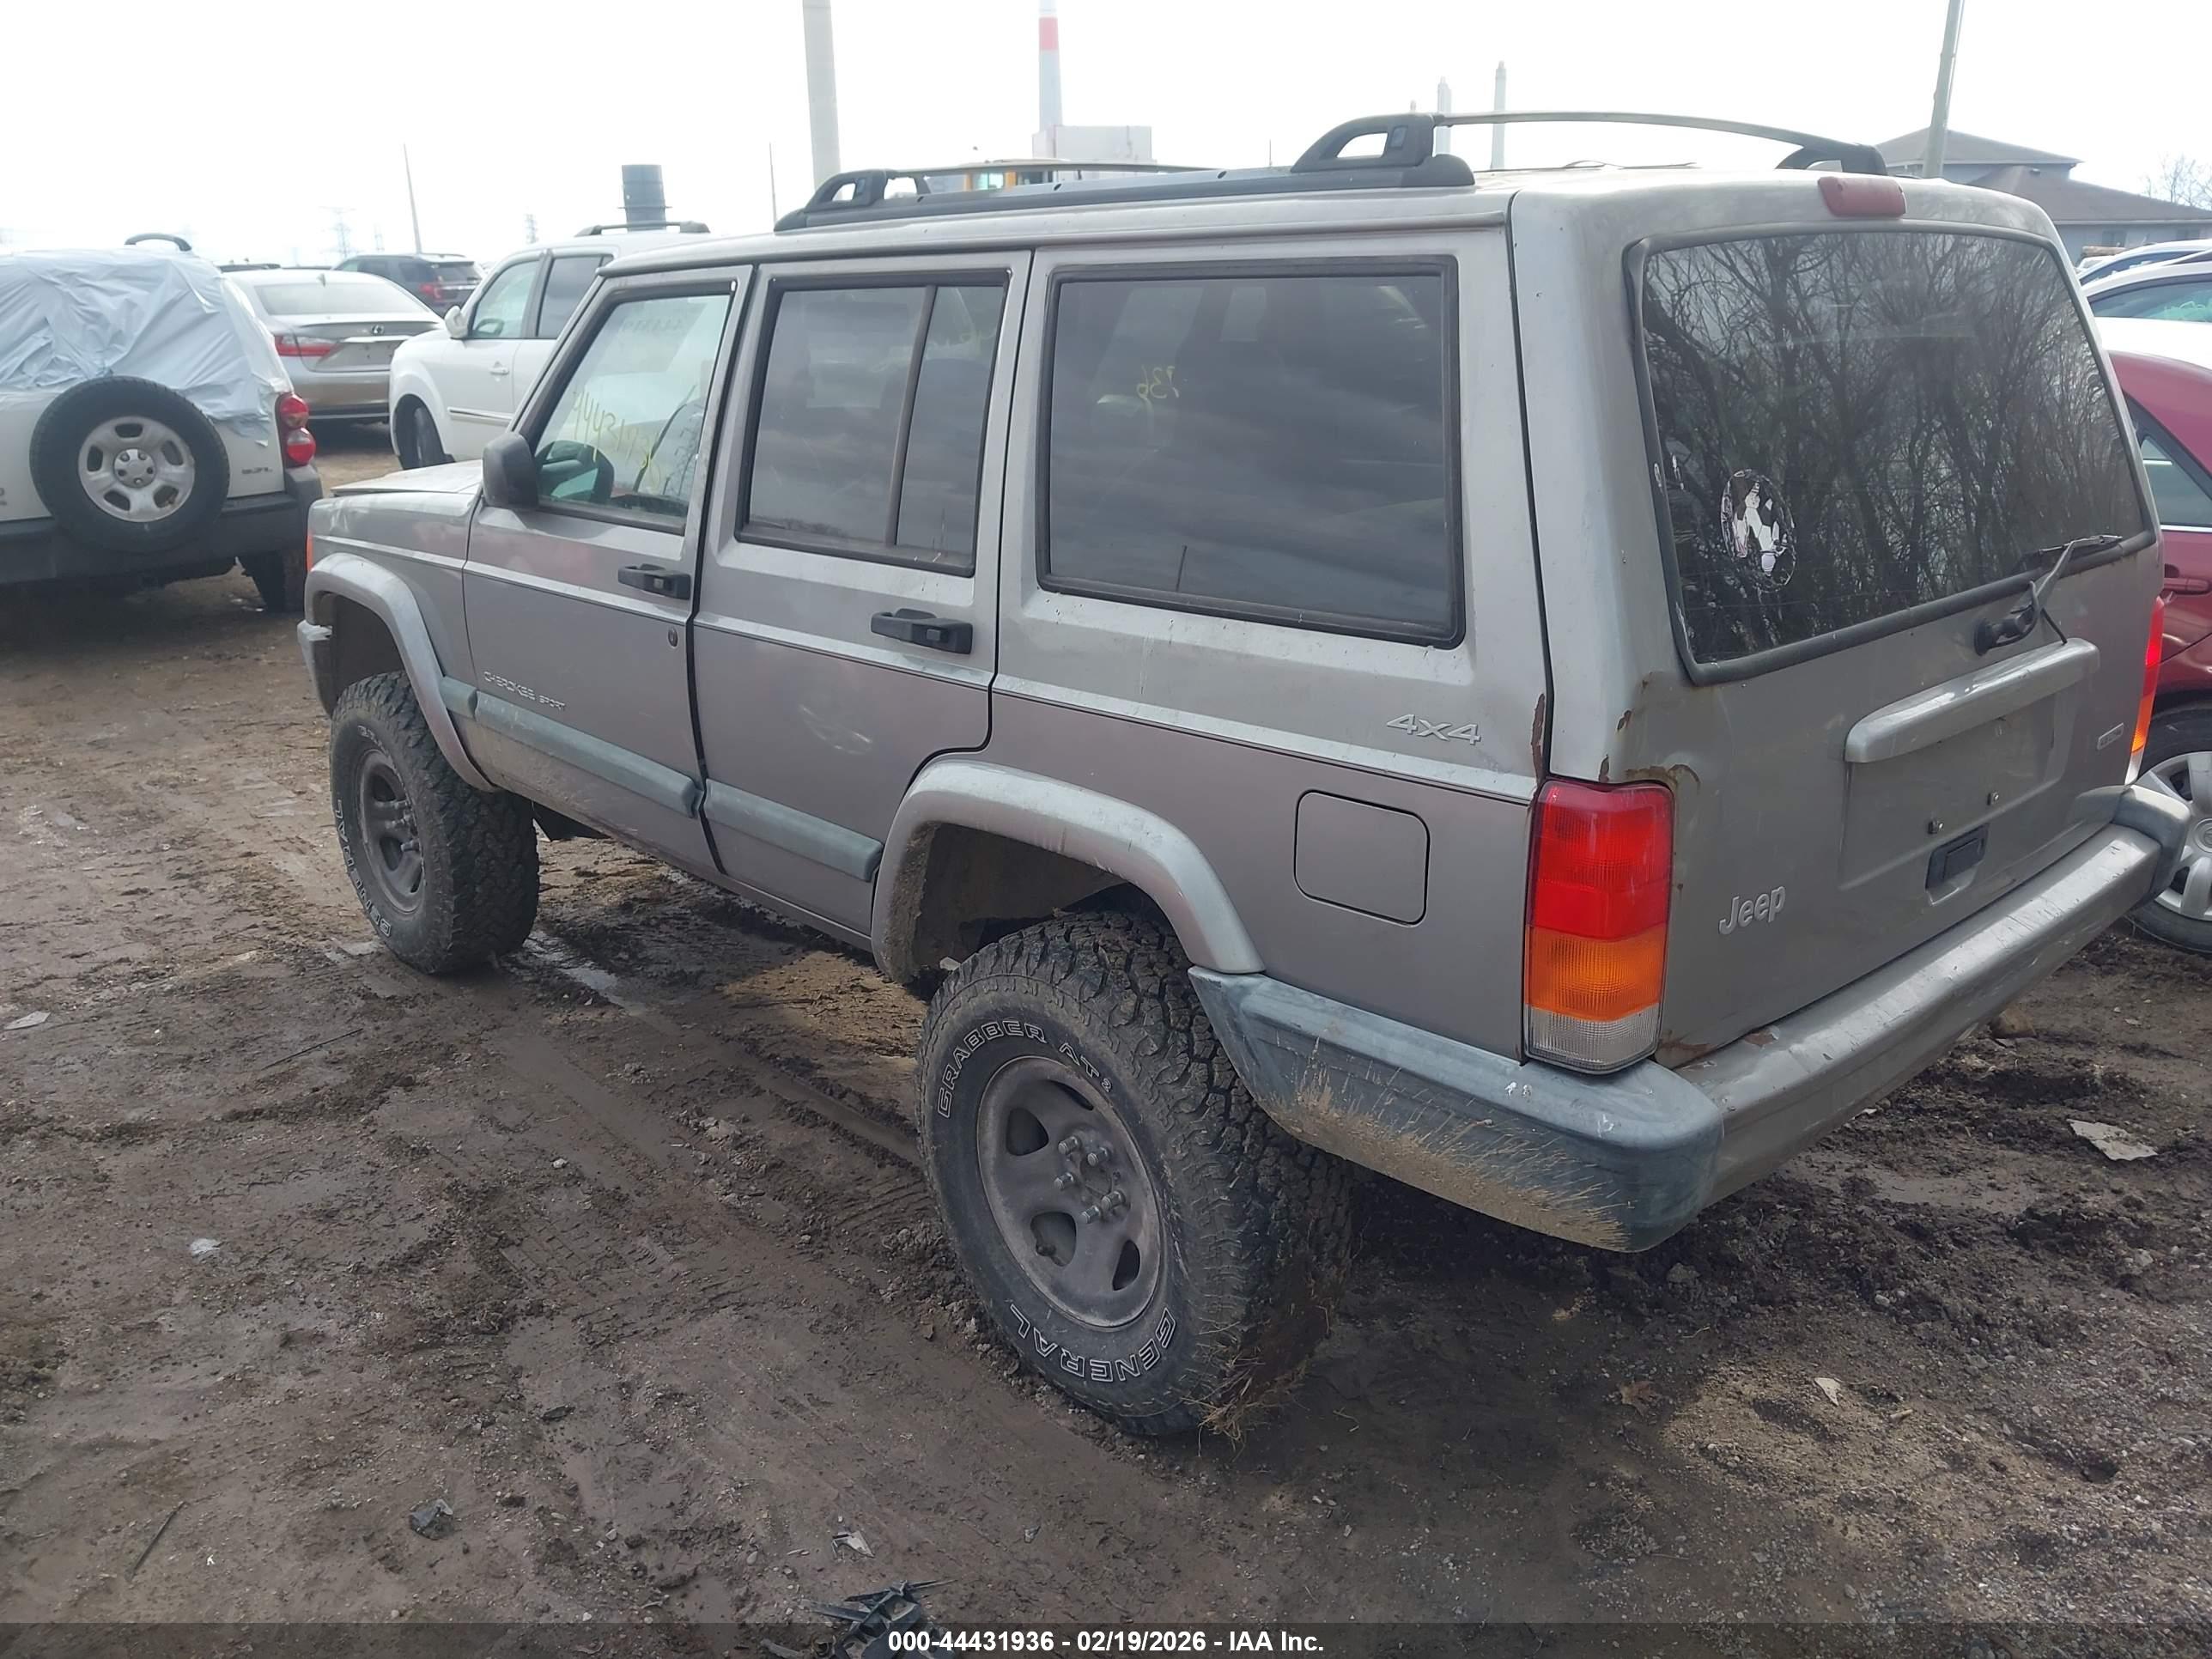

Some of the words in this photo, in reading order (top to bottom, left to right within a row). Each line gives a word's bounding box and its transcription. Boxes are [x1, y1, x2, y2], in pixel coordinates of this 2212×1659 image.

[1718, 885, 1786, 935] Jeep
[937, 1018, 1048, 1119] GRABBER
[1009, 1303, 1177, 1383] GENERAL
